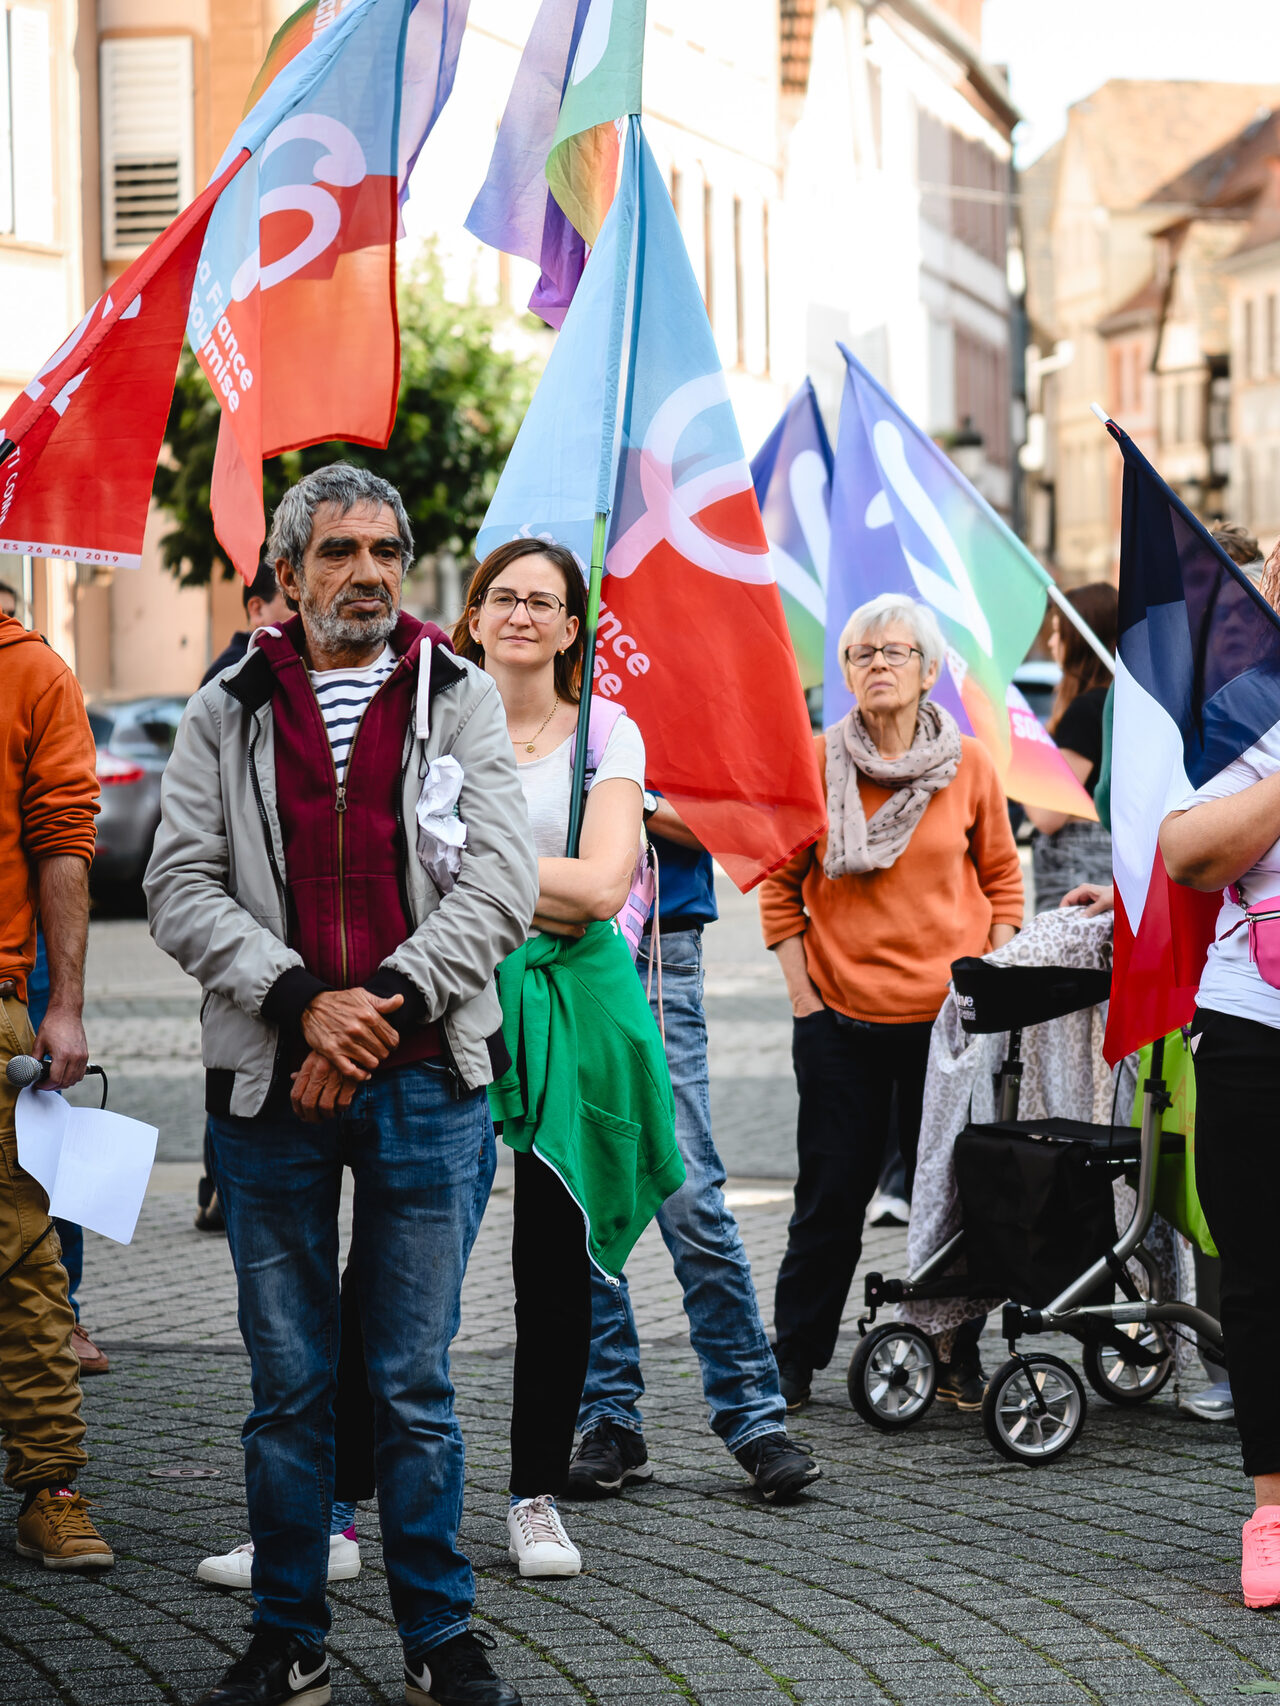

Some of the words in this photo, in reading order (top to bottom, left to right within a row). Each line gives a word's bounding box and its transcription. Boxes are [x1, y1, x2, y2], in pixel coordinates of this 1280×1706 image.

[189, 290, 240, 413] soumise
[206, 280, 253, 392] France
[7, 446, 20, 469] TI
[2, 543, 19, 551] ES
[51, 548, 77, 558] MAI
[85, 552, 119, 562] 2019
